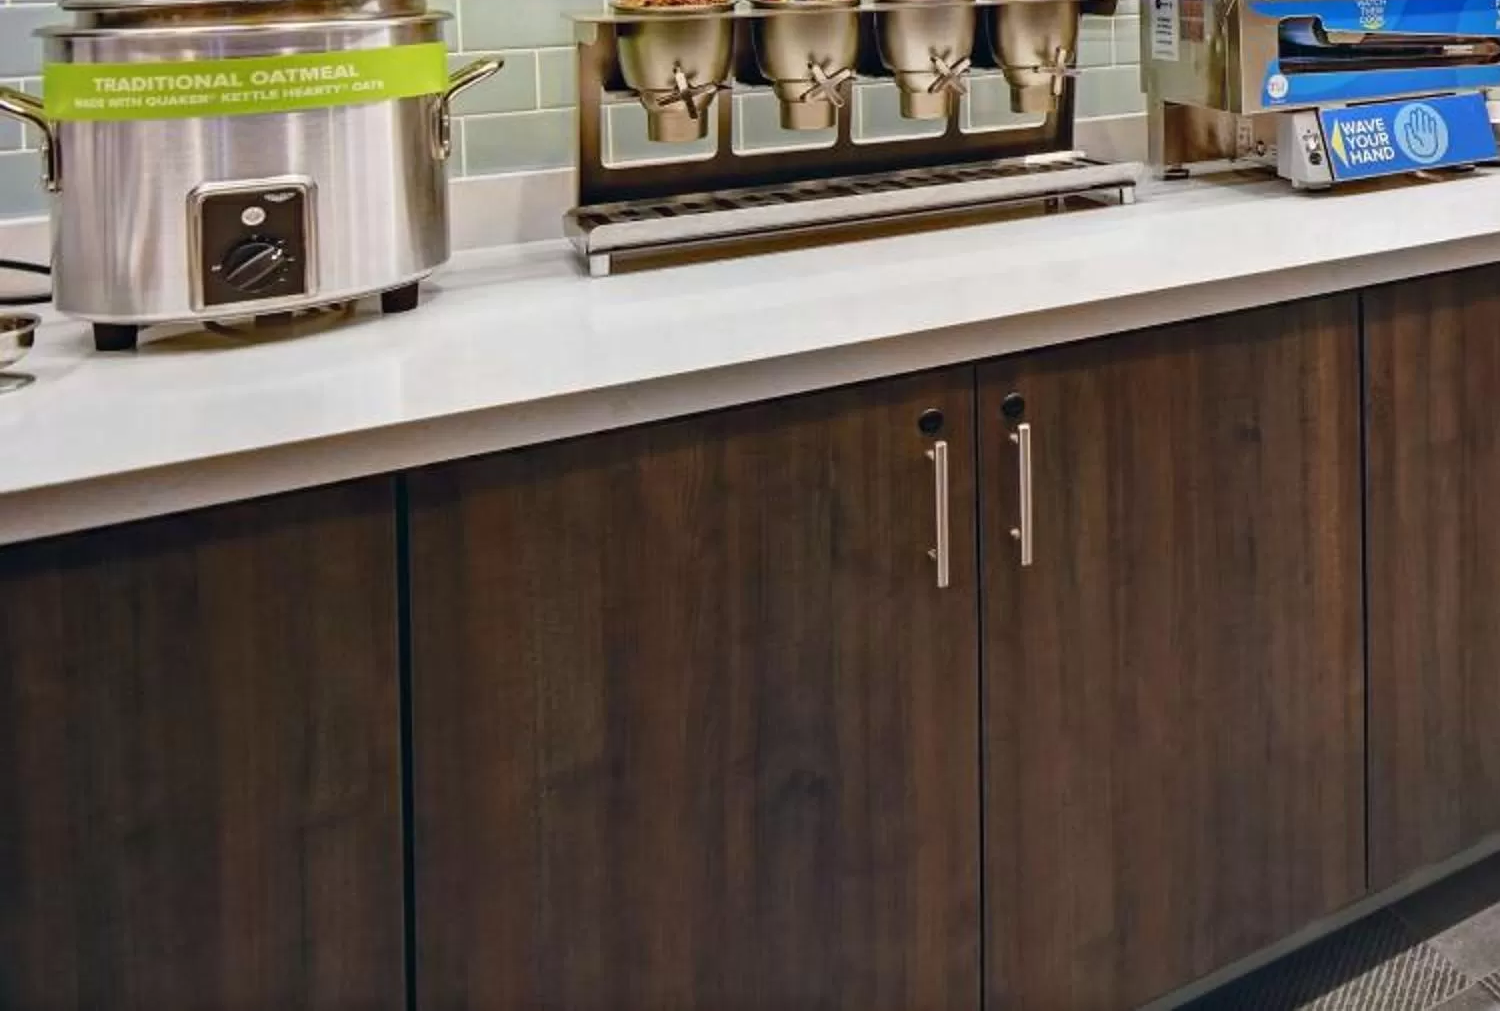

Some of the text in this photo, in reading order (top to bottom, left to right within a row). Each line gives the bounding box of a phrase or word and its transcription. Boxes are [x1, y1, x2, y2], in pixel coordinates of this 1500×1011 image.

[91, 64, 360, 93] TRADITIONAL OATMEAL
[220, 90, 280, 103] KETTLE
[1340, 117, 1386, 134] WAVE
[1345, 132, 1390, 151] YOUR
[1350, 147, 1396, 166] HAND
